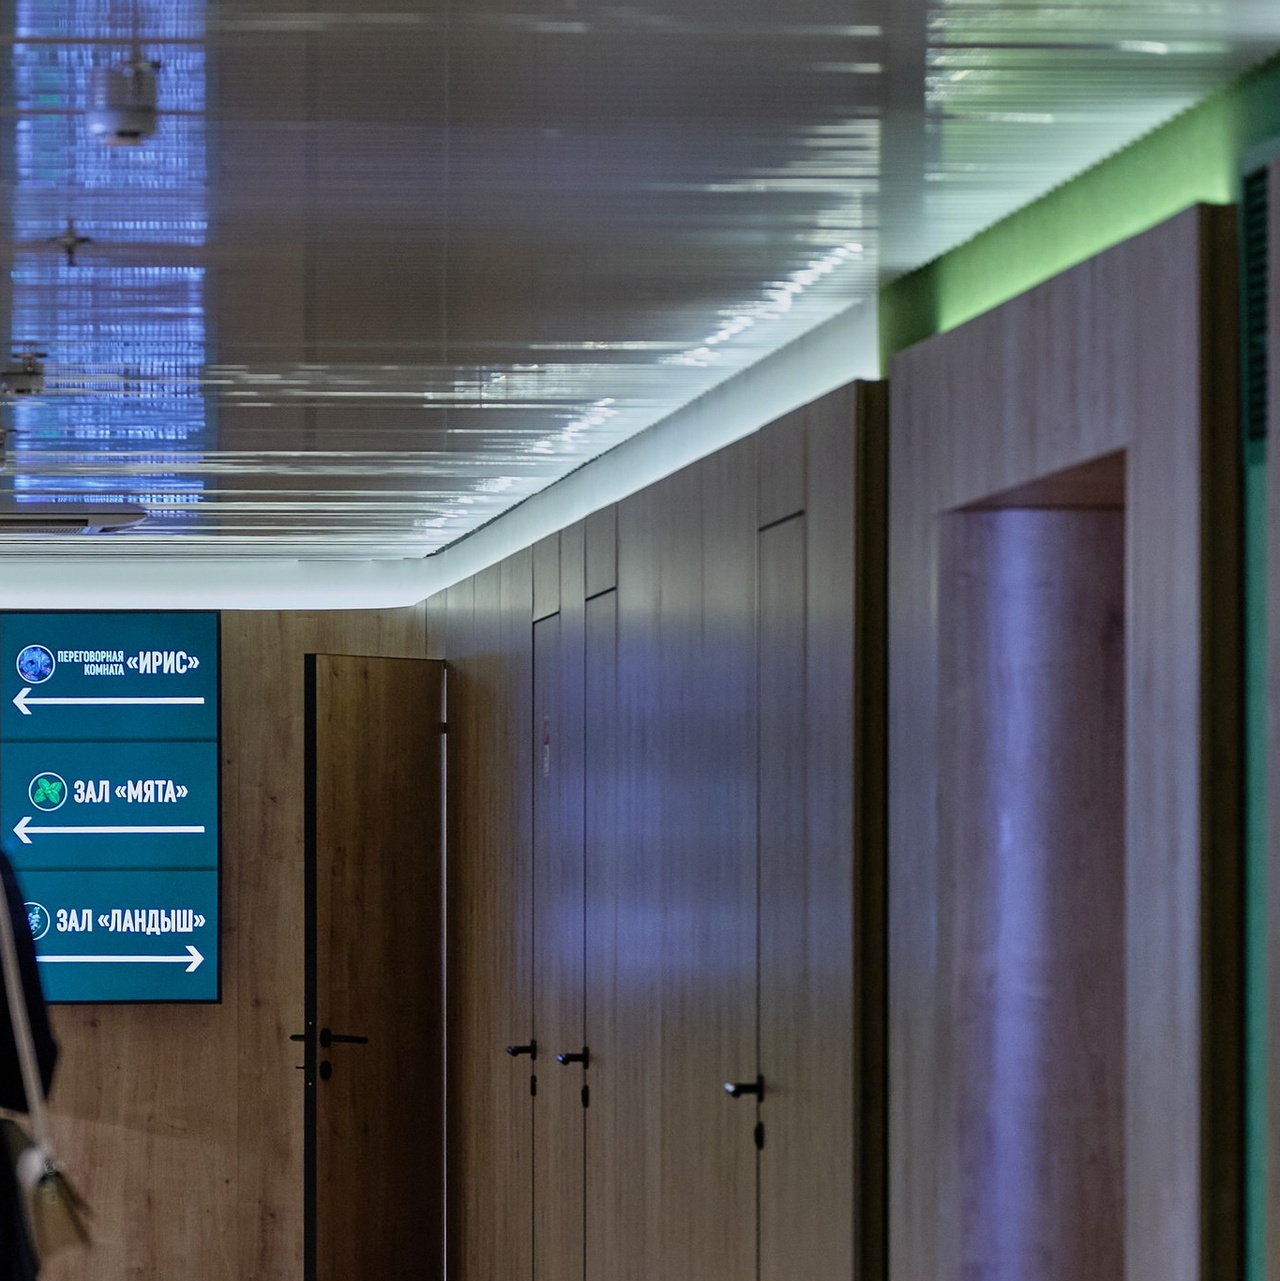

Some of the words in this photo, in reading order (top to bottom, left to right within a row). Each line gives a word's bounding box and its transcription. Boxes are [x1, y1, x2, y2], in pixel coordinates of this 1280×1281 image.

[57, 650, 124, 663] ПЕРЕГОВОРНАЯ
[126, 651, 200, 674] «ИРИС»
[84, 663, 125, 676] КОМНАТА
[73, 780, 110, 803] ЗАЛ
[114, 780, 189, 803] «МЯТА»
[56, 909, 93, 932] ЗАЛ
[97, 909, 206, 935] «ЛАНДЫШ»
